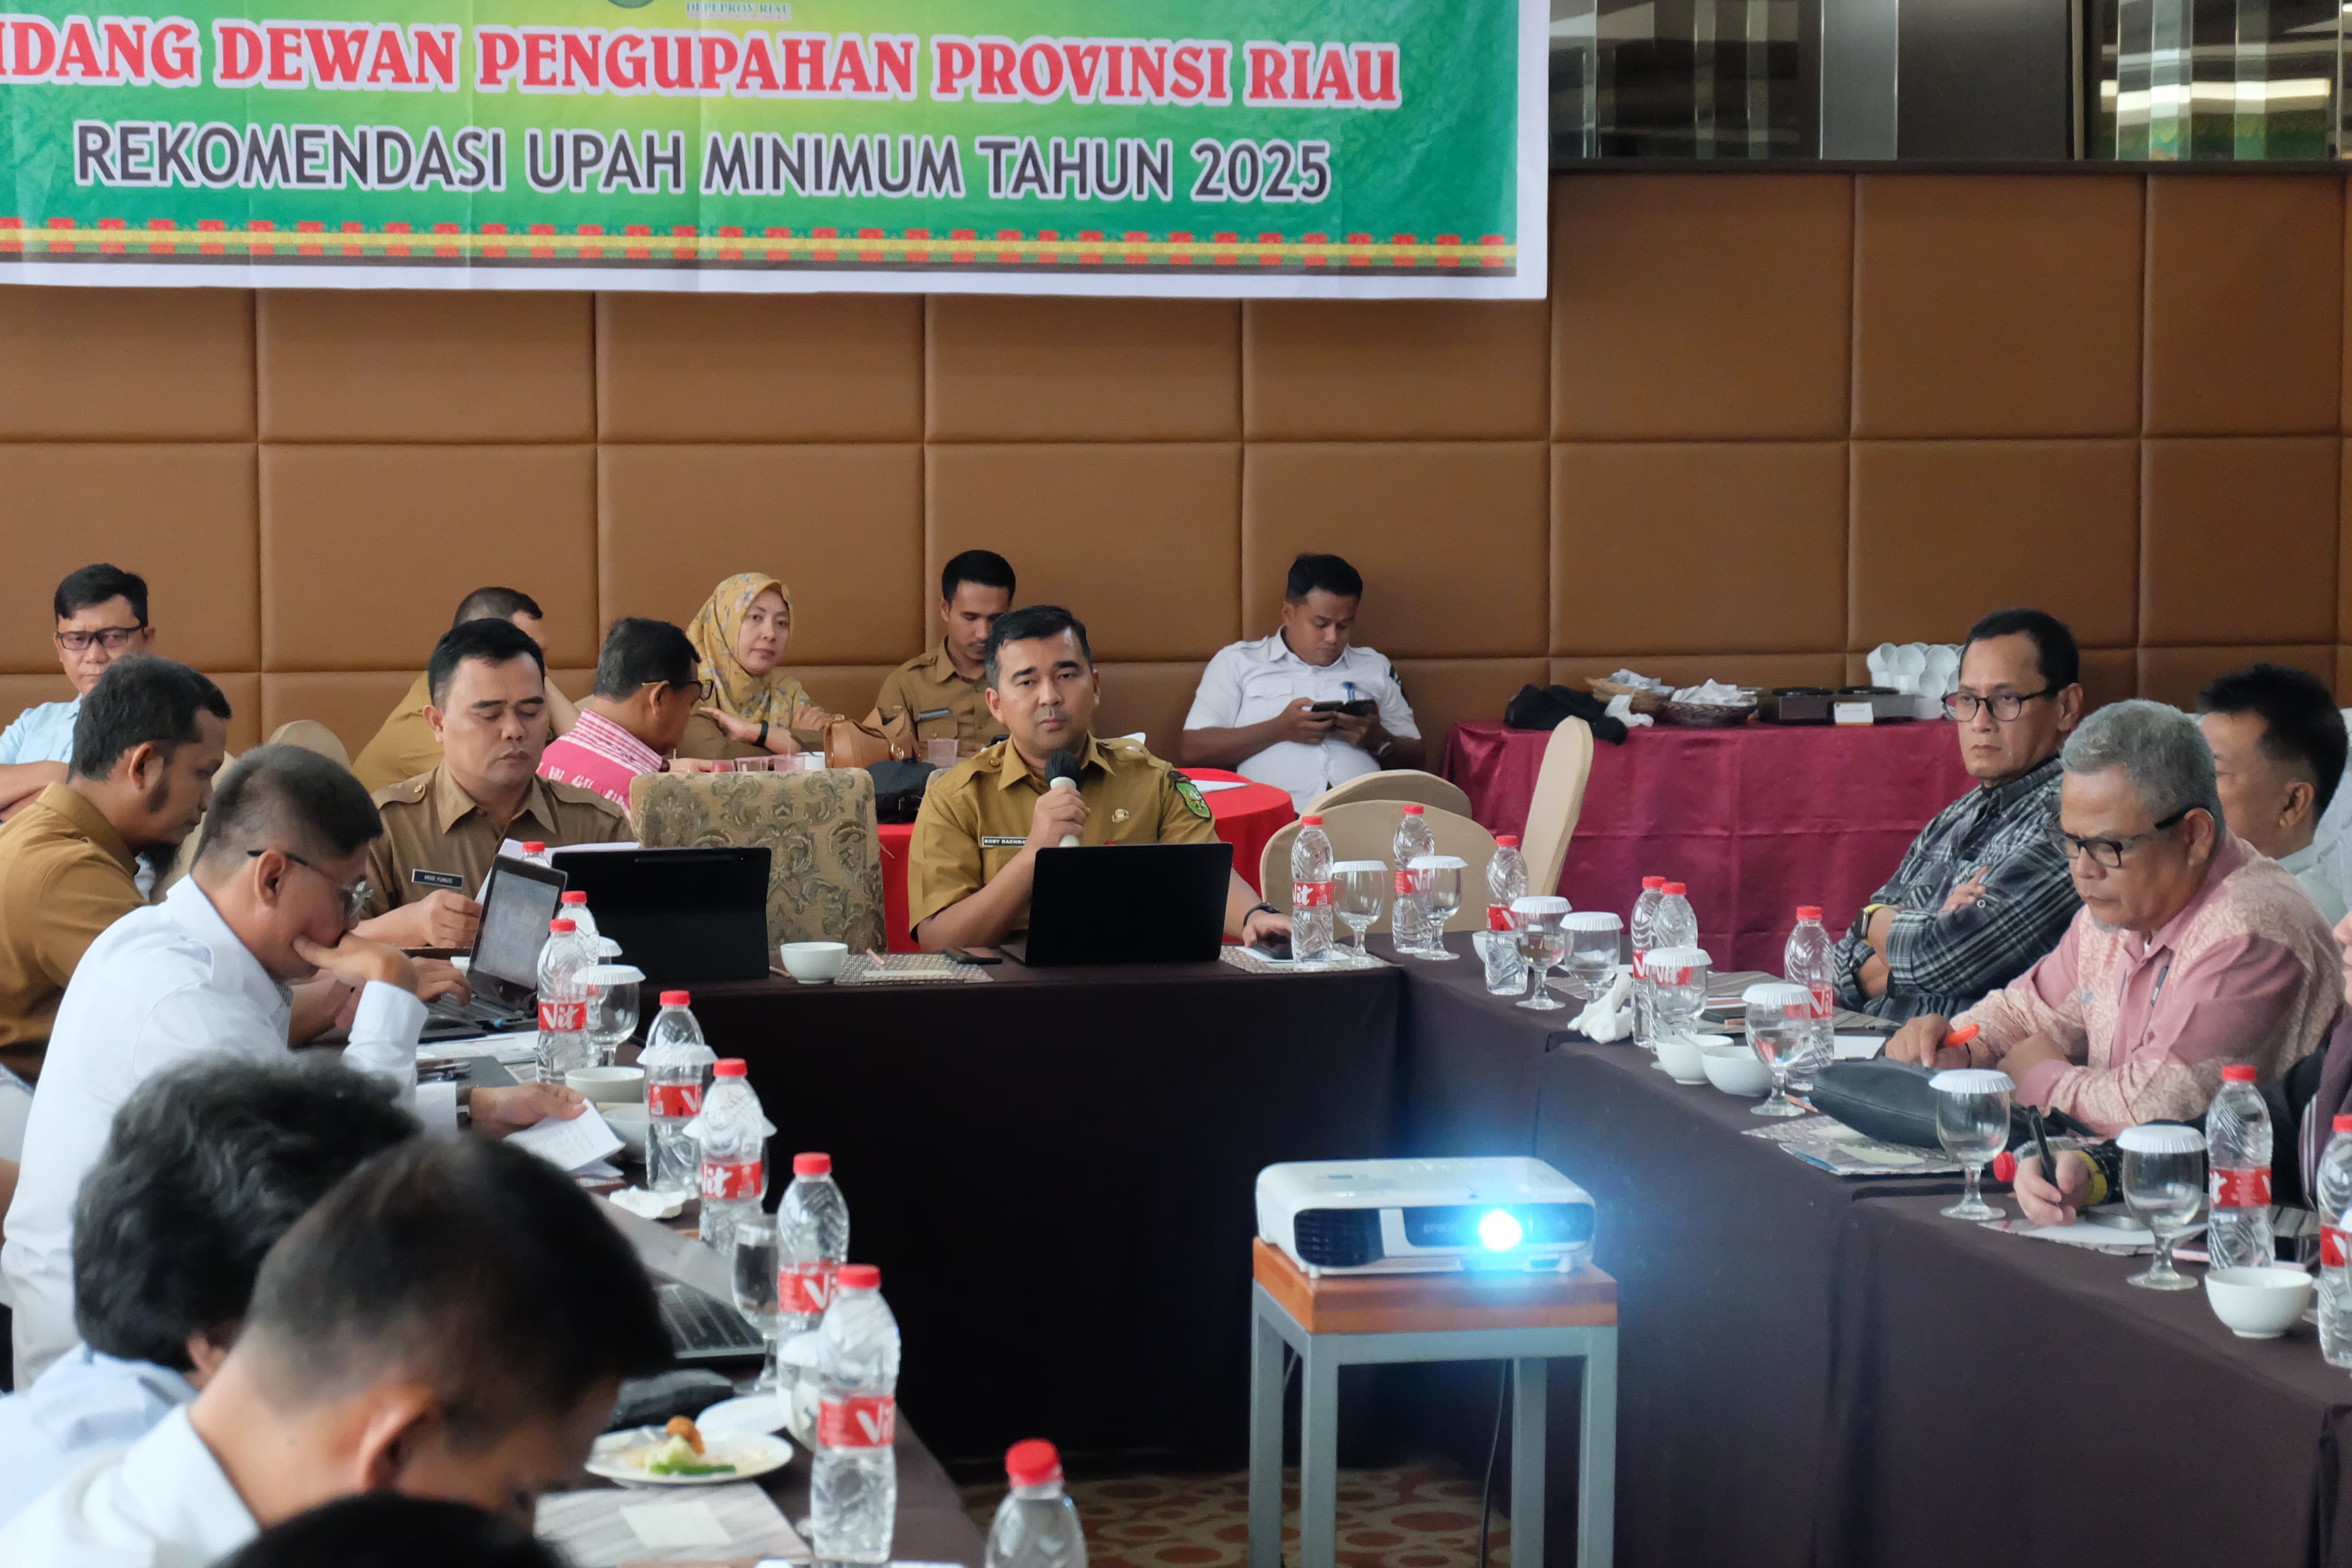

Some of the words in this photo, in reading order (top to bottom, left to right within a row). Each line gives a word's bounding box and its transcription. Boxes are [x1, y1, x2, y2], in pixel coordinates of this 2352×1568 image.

[220, 27, 455, 84] DEWAN
[479, 32, 913, 93] PENGUPAHAN
[937, 42, 1226, 99] PROVINSI
[1250, 48, 1396, 101] RIAU
[80, 126, 501, 185] REKOMENDASI
[530, 135, 681, 188] UPAH
[706, 138, 960, 192] MINIMUM
[979, 142, 1168, 195] TAHUN
[1196, 145, 1326, 197] 2025
[542, 1002, 579, 1029] Vit
